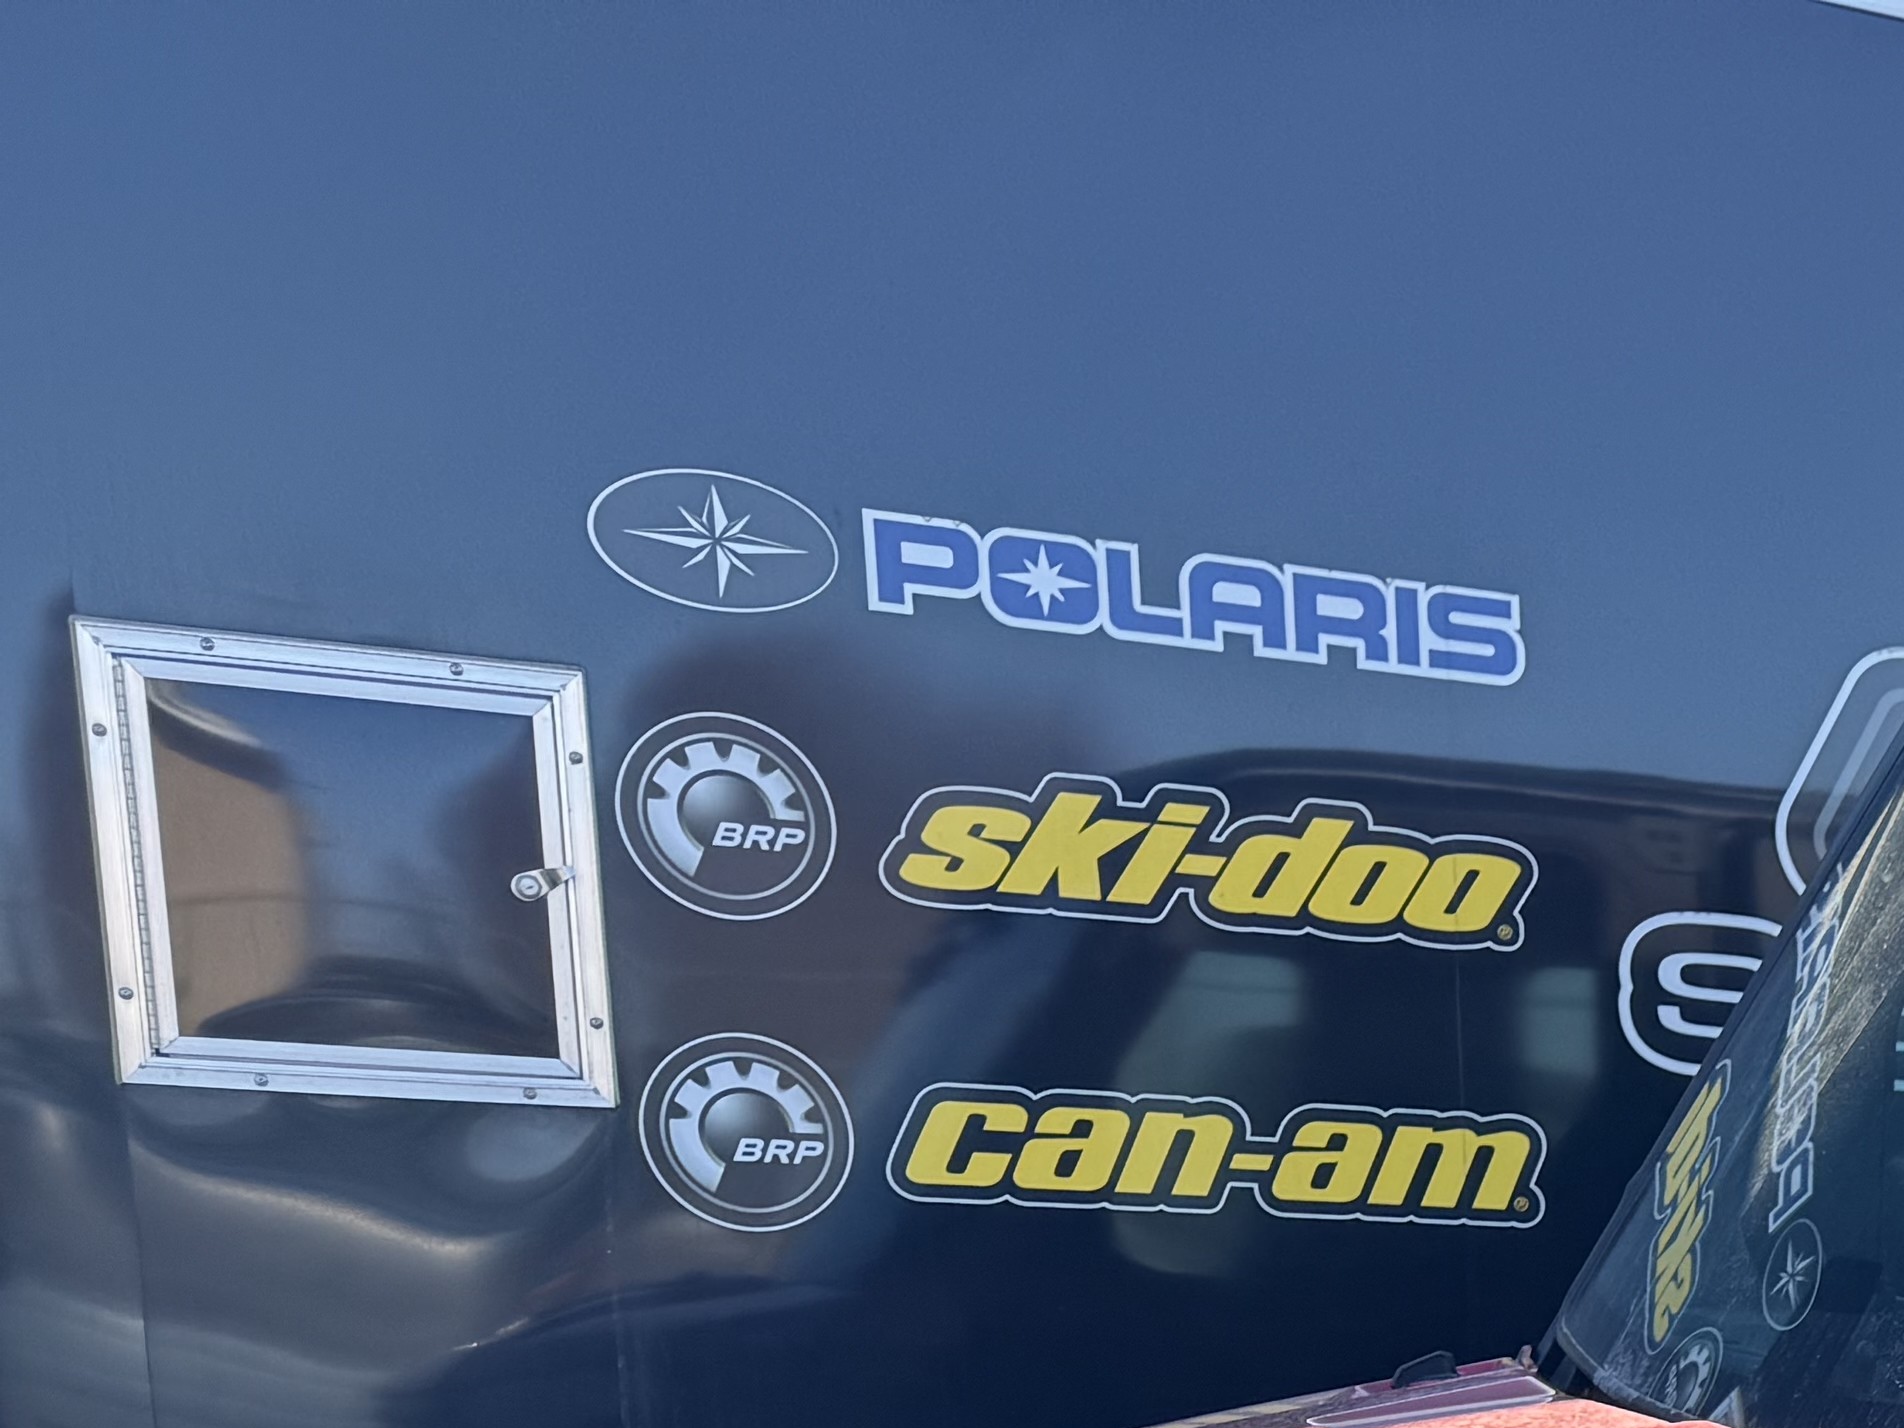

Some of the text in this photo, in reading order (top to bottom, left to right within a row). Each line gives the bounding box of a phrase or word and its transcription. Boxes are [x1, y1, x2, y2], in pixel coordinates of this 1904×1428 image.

[862, 507, 1525, 686] POLARIS
[712, 821, 806, 852] BRP
[900, 792, 1522, 933] ski-doo
[733, 1137, 825, 1165] BRP
[909, 1100, 1529, 1210] can-am
